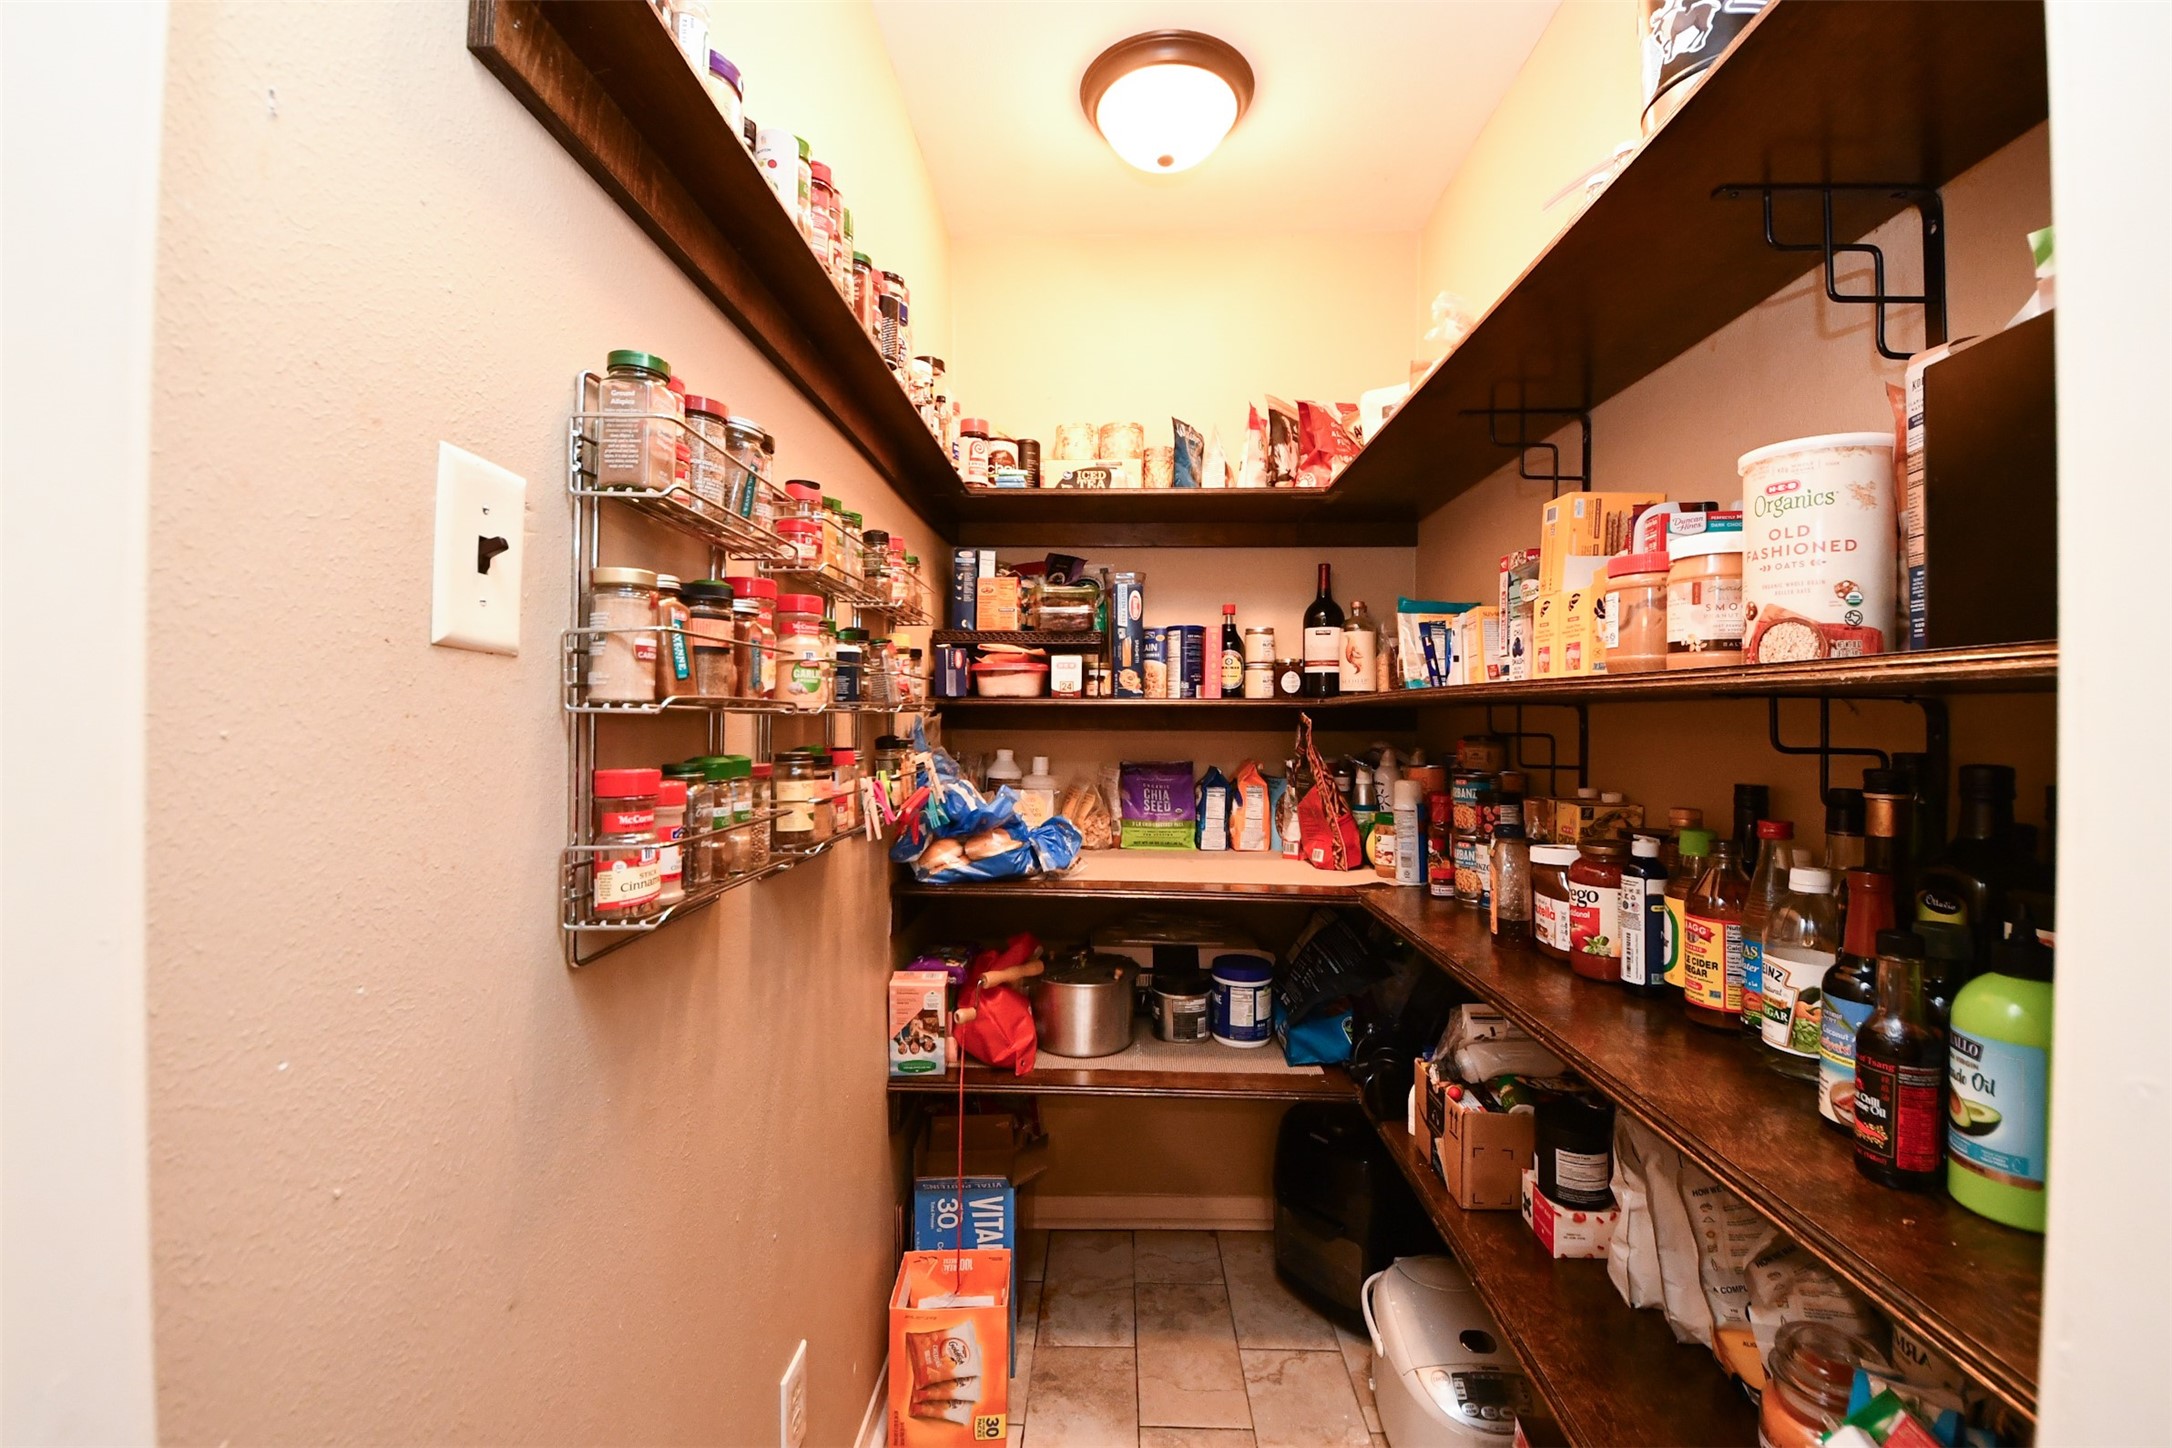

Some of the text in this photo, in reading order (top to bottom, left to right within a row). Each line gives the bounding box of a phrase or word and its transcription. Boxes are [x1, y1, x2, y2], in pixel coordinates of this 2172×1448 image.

[1077, 471, 1107, 480] ICED
[1077, 480, 1107, 489] TEA
[1754, 489, 1836, 518] Organics
[1672, 515, 1704, 527] Duncan
[1676, 522, 1703, 532] Hines
[1769, 525, 1810, 541] OLD
[1746, 539, 1858, 563] FASHIONED
[1775, 561, 1805, 571] OATS
[1061, 683, 1074, 692] 24
[1143, 788, 1170, 801] CHIA
[1143, 800, 1172, 812] SEED
[1691, 957, 1719, 971] CIDER
[1822, 1024, 1849, 1041] Coconut
[1867, 1056, 1895, 1072] Tsang
[1956, 1057, 1979, 1070] VIRGIN
[1972, 1073, 1996, 1097] Oil
[1870, 1107, 1887, 1119] Oil
[1692, 1184, 1723, 1197] HOW WE
[937, 1198, 959, 1229] 30
[986, 1417, 1001, 1438] 30
